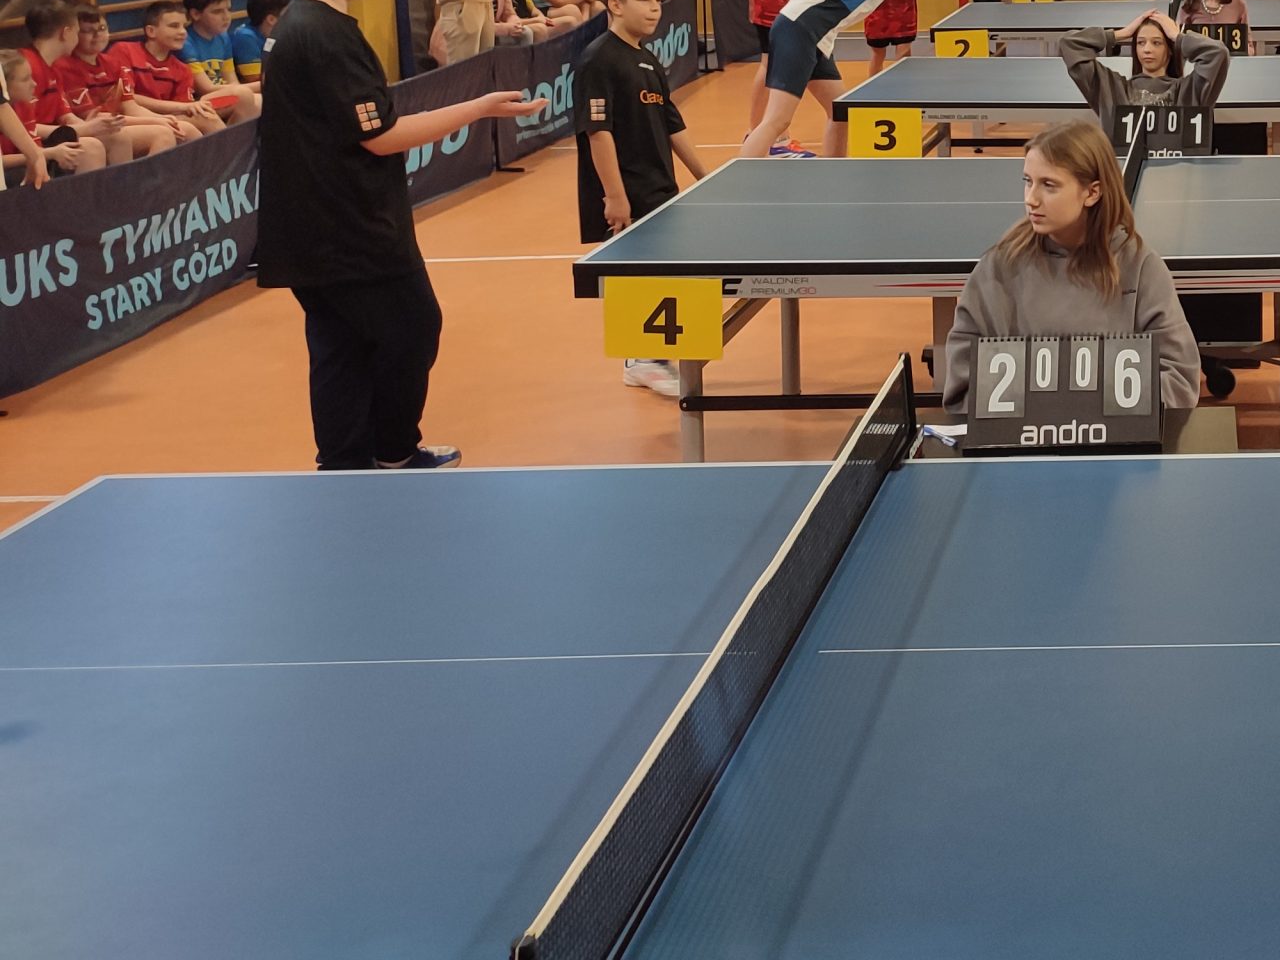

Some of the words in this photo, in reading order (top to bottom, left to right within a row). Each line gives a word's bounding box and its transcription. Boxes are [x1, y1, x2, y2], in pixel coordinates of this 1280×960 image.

[954, 39, 970, 57] 2
[1231, 29, 1241, 50] 3
[873, 120, 897, 151] 3
[1121, 112, 1134, 143] 1
[1146, 110, 1156, 132] 0
[1167, 111, 1178, 132] 0
[1190, 113, 1203, 145] 1
[1148, 147, 1183, 157] ndro
[0, 239, 79, 307] UKS
[99, 171, 260, 274] TYMIANK
[85, 268, 163, 330] STARY
[172, 238, 238, 291] GÓZD
[750, 286, 817, 295] PREMIUM30
[751, 277, 809, 285] WALDNER
[643, 297, 684, 345] 4
[987, 352, 1017, 413] 2
[1035, 347, 1052, 388] 0
[1075, 347, 1092, 388] 0
[1114, 349, 1141, 409] 6
[1020, 419, 1107, 445] andro
